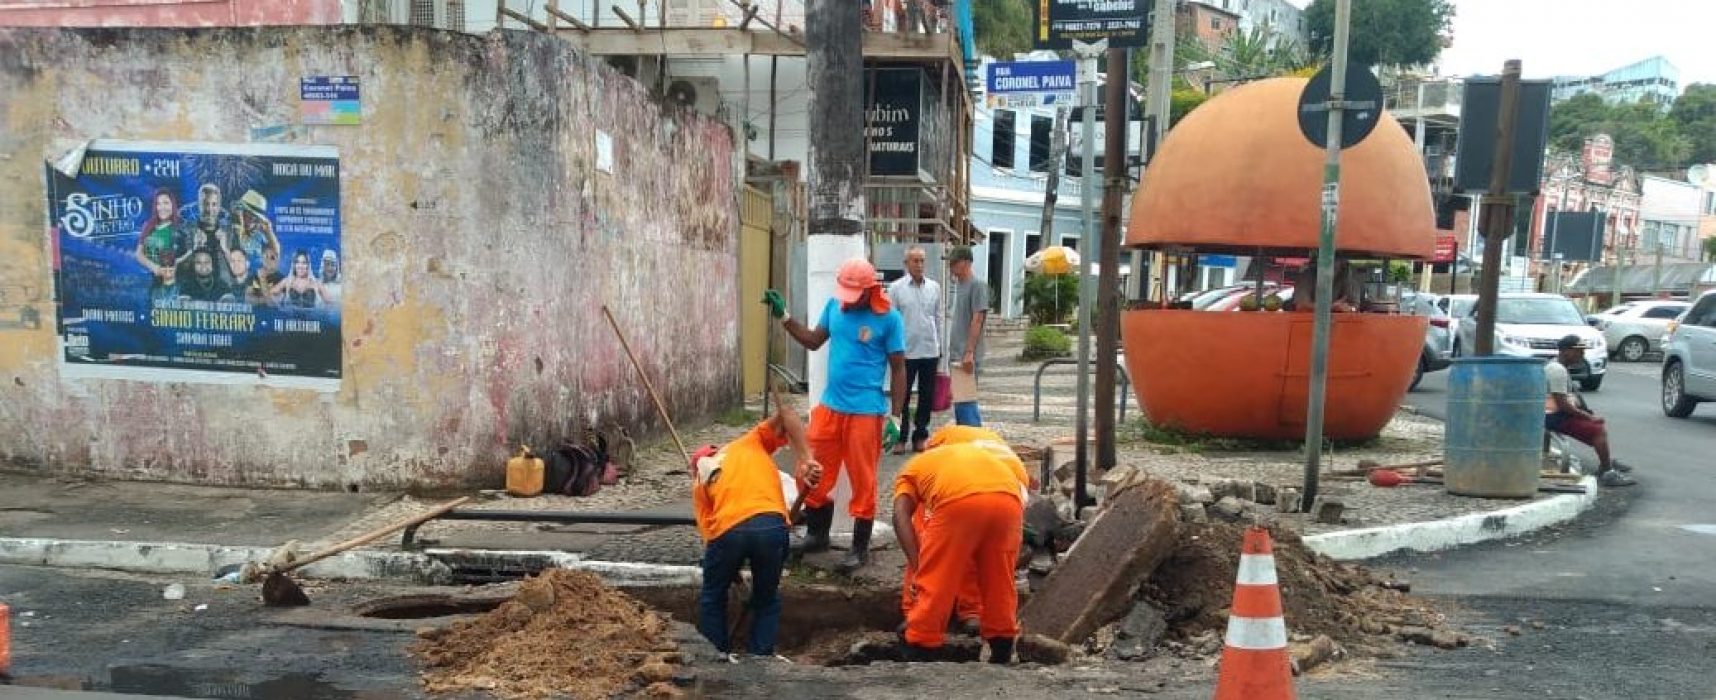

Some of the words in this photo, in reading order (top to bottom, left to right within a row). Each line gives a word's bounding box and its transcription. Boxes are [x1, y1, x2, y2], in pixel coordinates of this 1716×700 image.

[995, 76, 1039, 90] CORONEL
[1042, 75, 1072, 88] PAIVA
[153, 159, 180, 178] 22H
[61, 193, 143, 238] SINHO
[151, 309, 193, 328] SINHO
[196, 311, 256, 331] FERRARY
